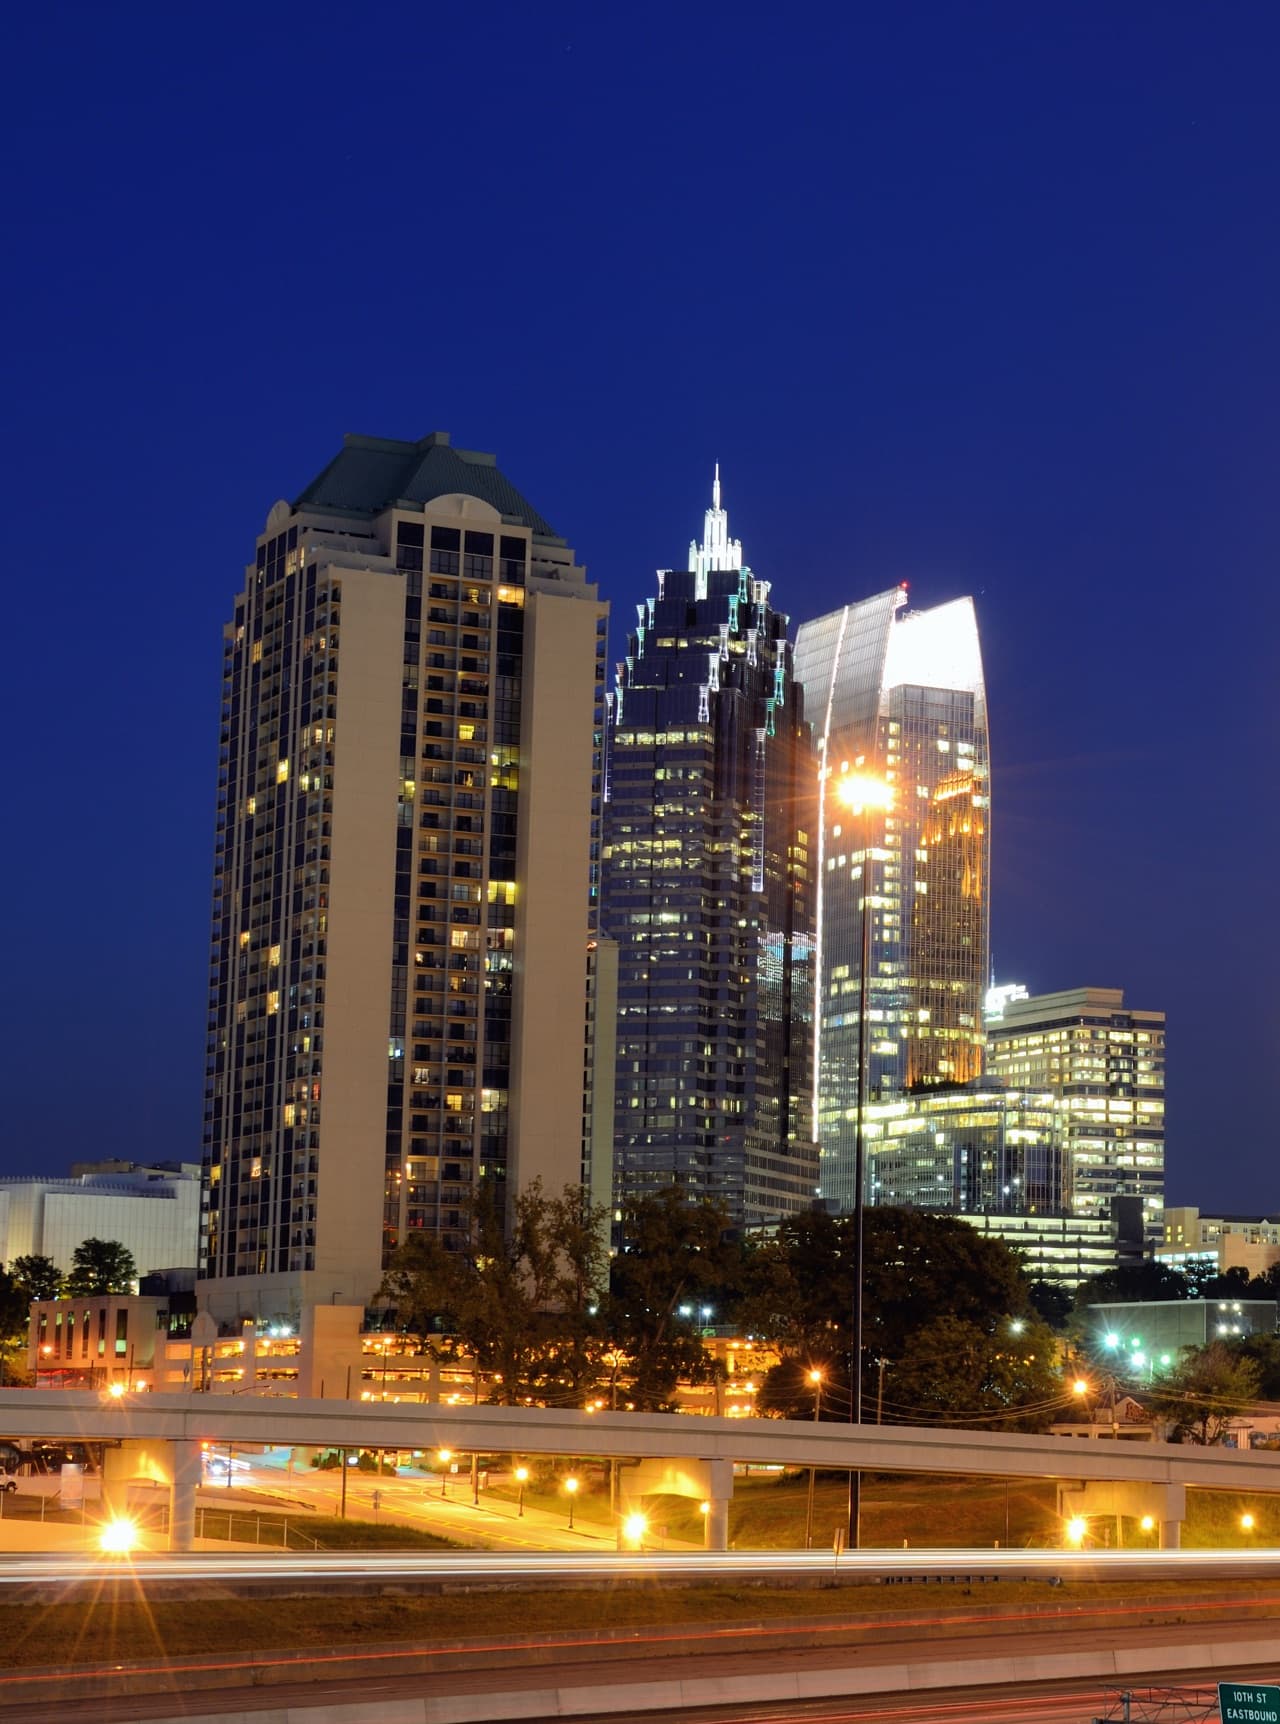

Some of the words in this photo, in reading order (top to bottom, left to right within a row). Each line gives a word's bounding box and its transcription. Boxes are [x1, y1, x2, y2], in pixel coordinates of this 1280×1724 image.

[1233, 1691, 1253, 1703] 10TH
[1256, 1693, 1267, 1704] ST
[1227, 1708, 1277, 1722] EASTBOUND
